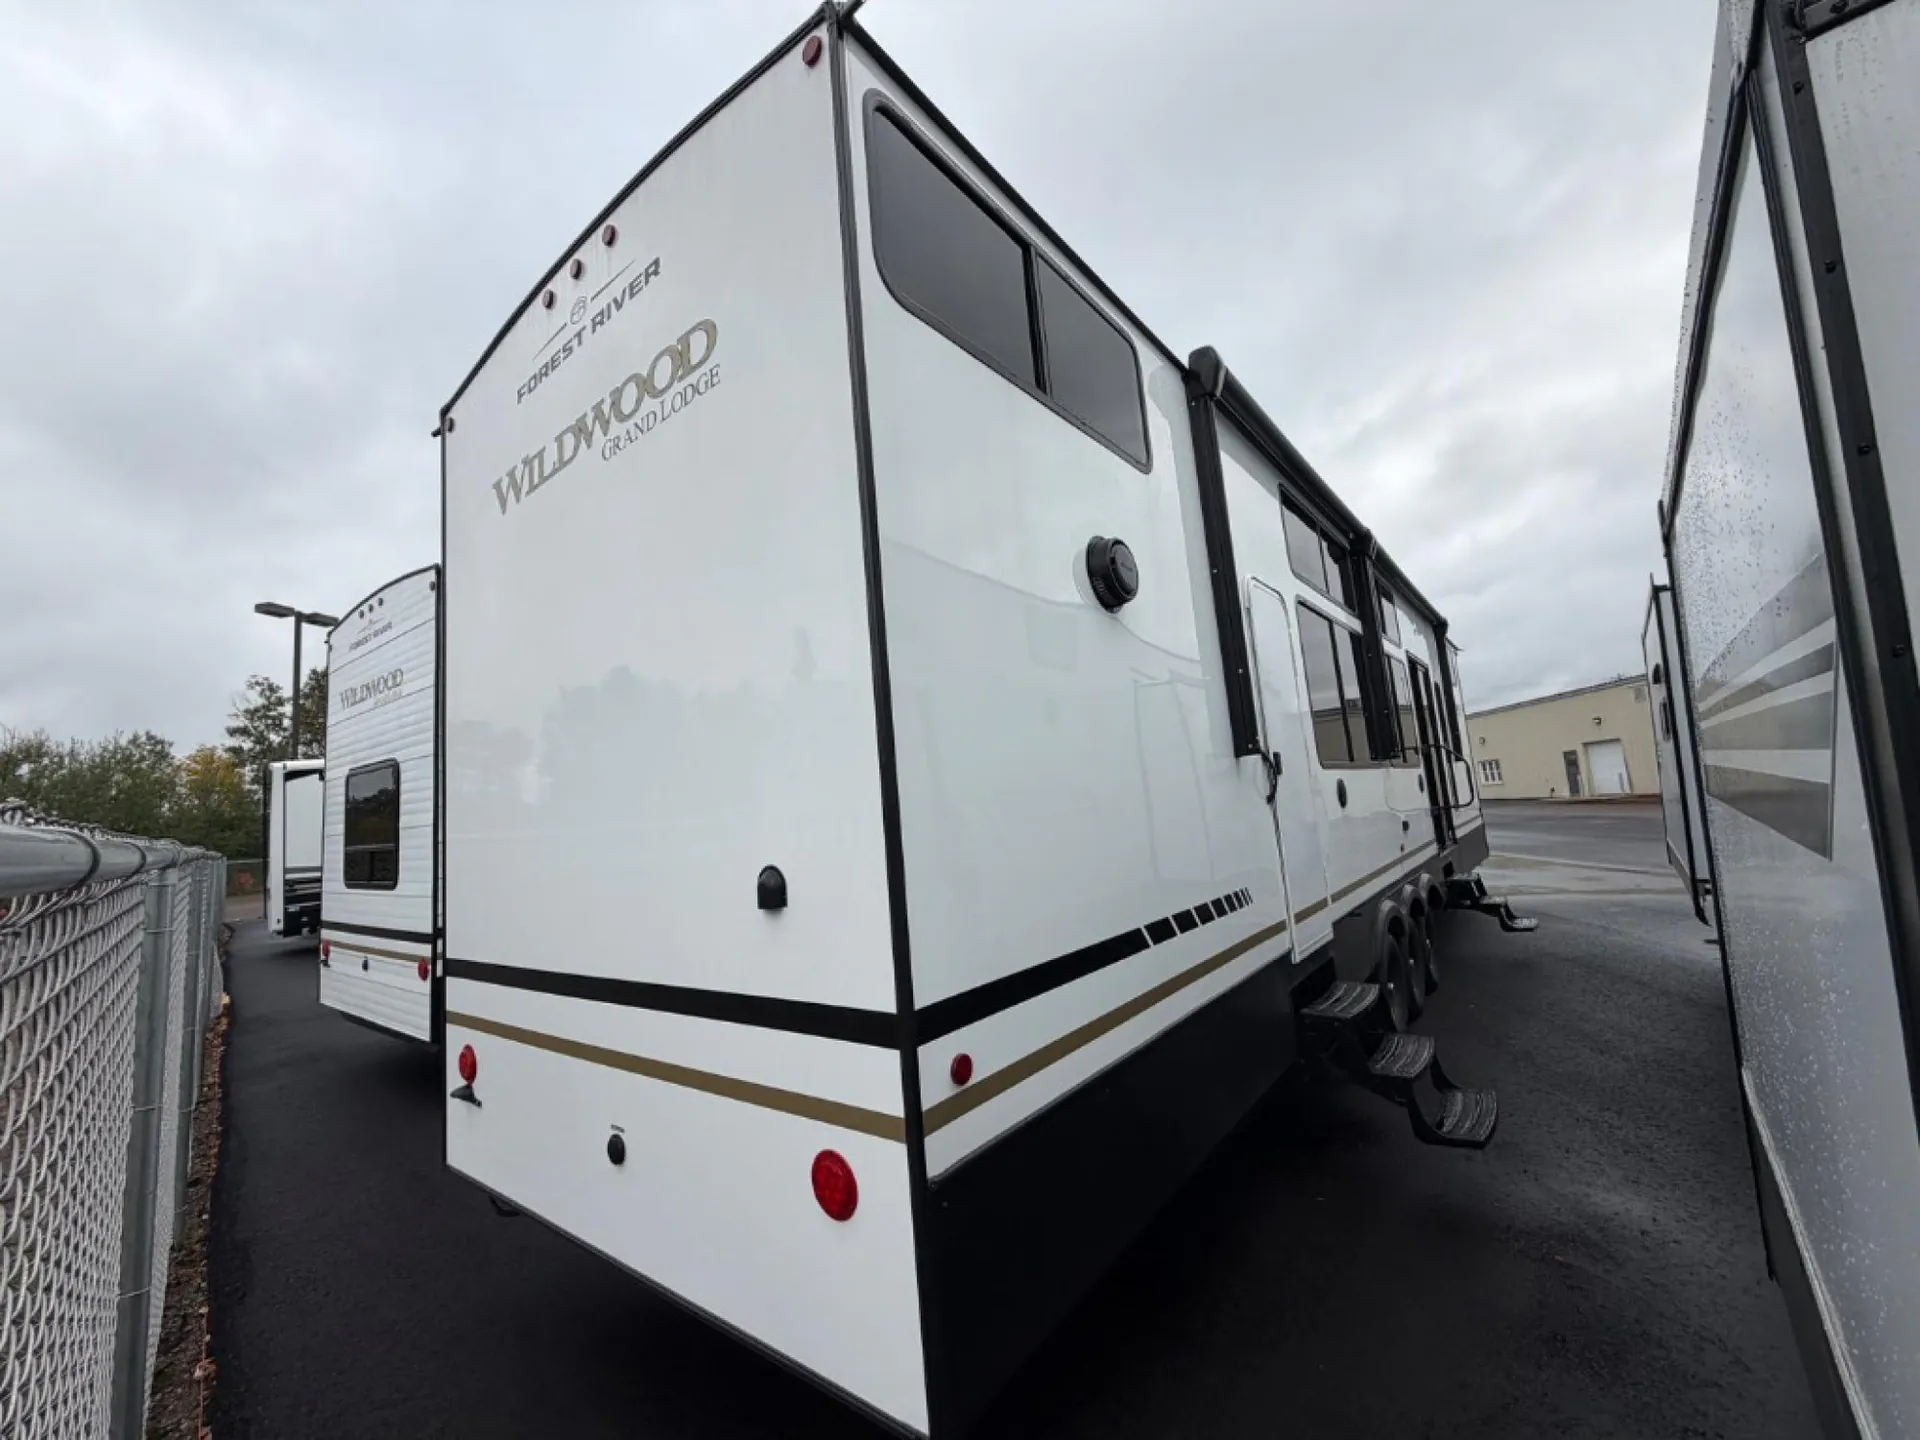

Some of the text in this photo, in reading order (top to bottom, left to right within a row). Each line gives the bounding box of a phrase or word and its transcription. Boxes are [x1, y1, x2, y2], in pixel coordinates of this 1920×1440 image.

[516, 256, 661, 405] FOREST RIVER
[493, 319, 718, 515] WILDWOOD
[601, 364, 720, 461] GRAND LODGE
